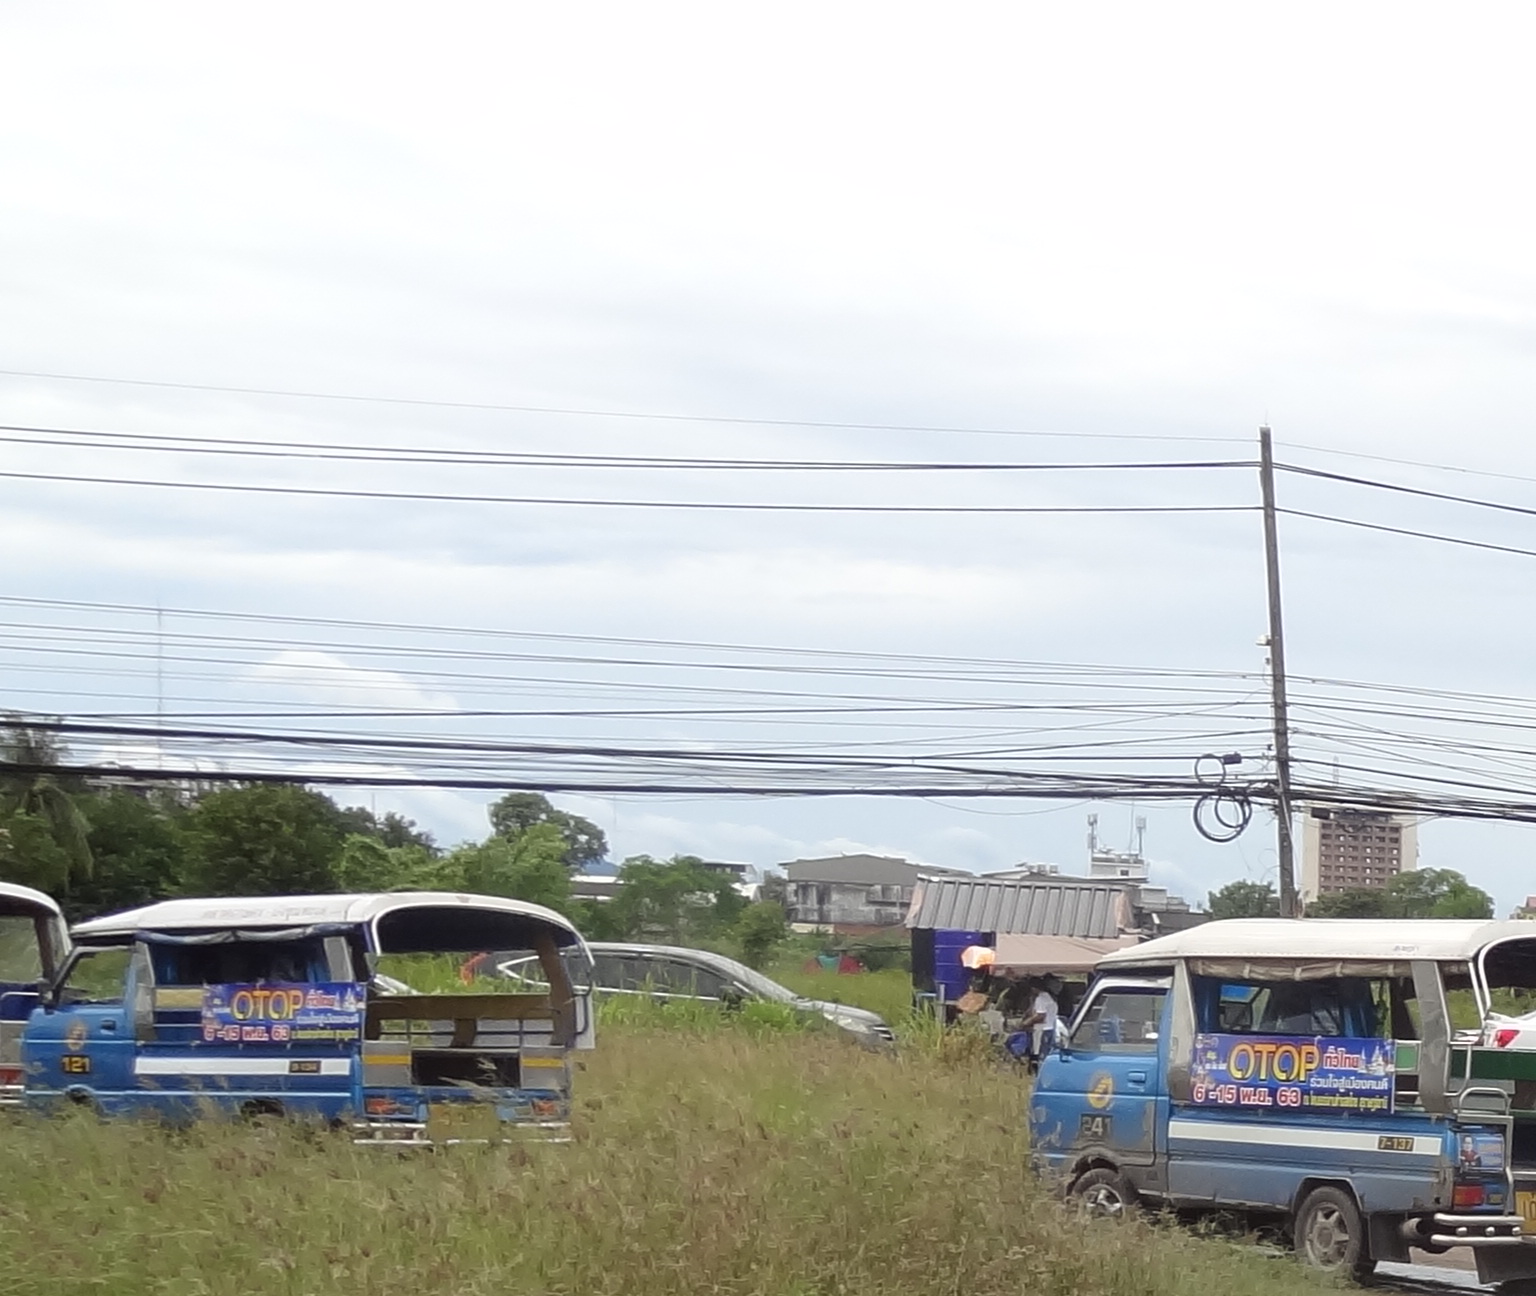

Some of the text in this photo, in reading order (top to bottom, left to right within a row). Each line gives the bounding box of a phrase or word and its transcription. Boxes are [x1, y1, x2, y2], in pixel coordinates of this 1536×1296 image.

[231, 986, 304, 1022] OTOP
[62, 1056, 91, 1073] 121
[1228, 1043, 1321, 1082] OTOP
[1193, 1083, 1206, 1103] 6
[1208, 1084, 1238, 1104] -15
[1276, 1086, 1302, 1107] 63
[1380, 1137, 1412, 1150] 7-137
